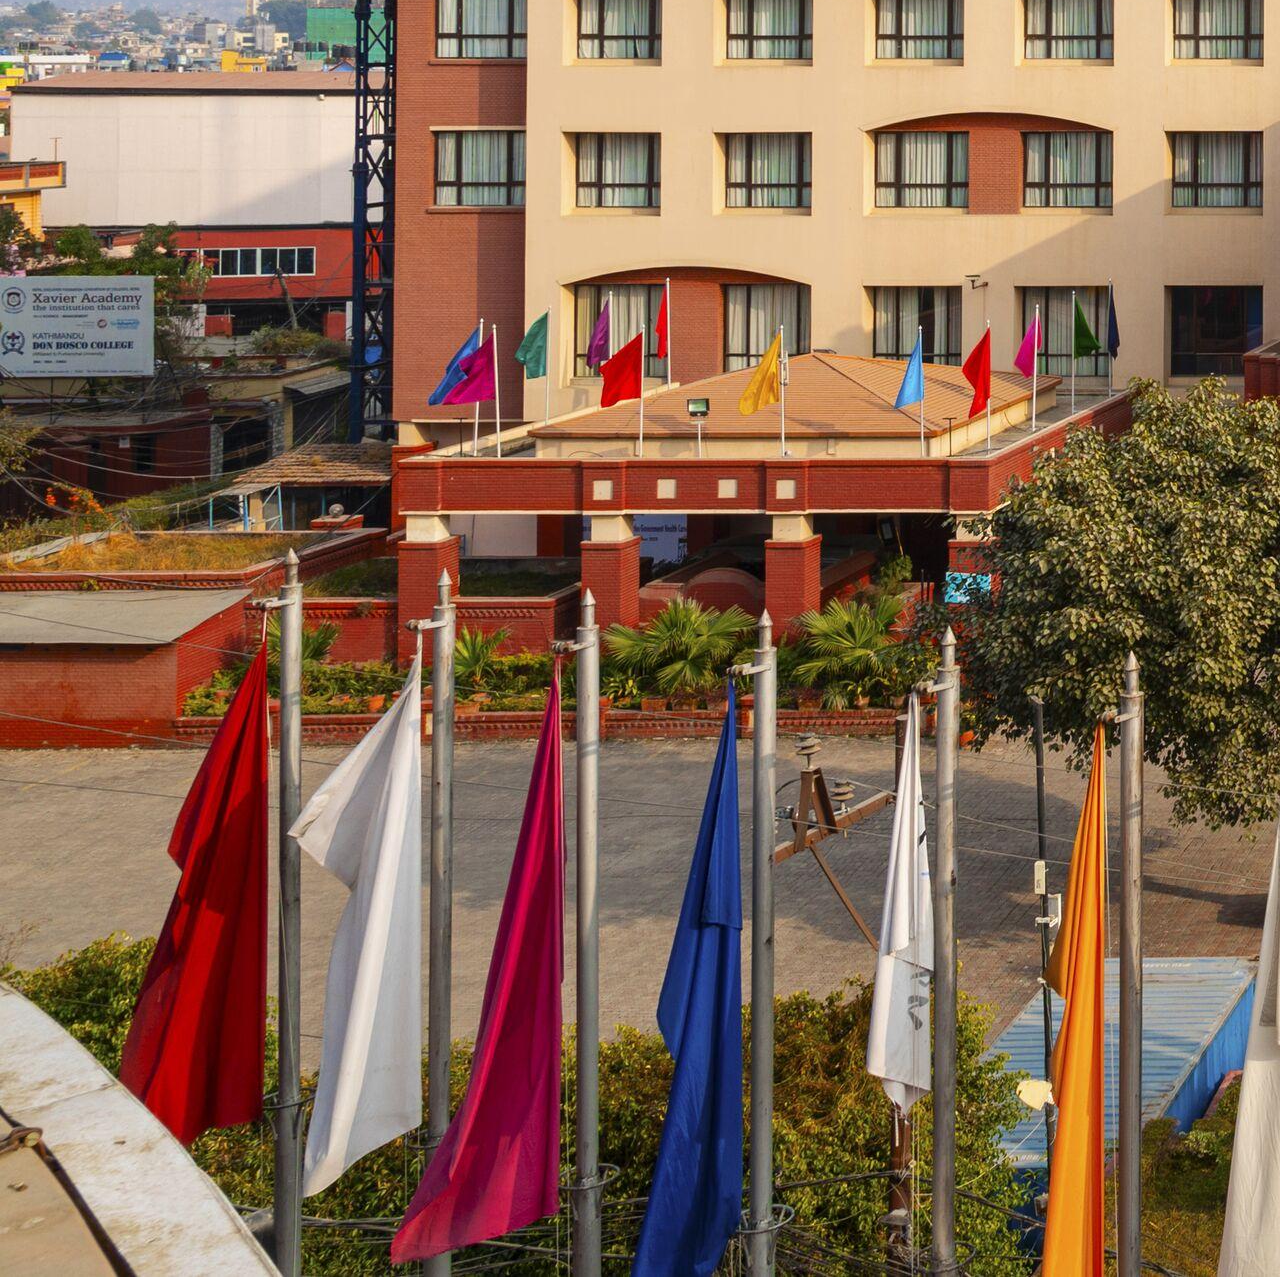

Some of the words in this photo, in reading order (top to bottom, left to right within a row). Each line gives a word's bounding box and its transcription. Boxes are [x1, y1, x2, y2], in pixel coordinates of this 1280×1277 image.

[32, 293, 77, 303] Xavier
[81, 293, 142, 306] Academy
[32, 332, 85, 340] KATHMANDU
[32, 341, 53, 350] DON
[56, 341, 88, 350] BOSCO
[90, 341, 134, 350] COLLEGE
